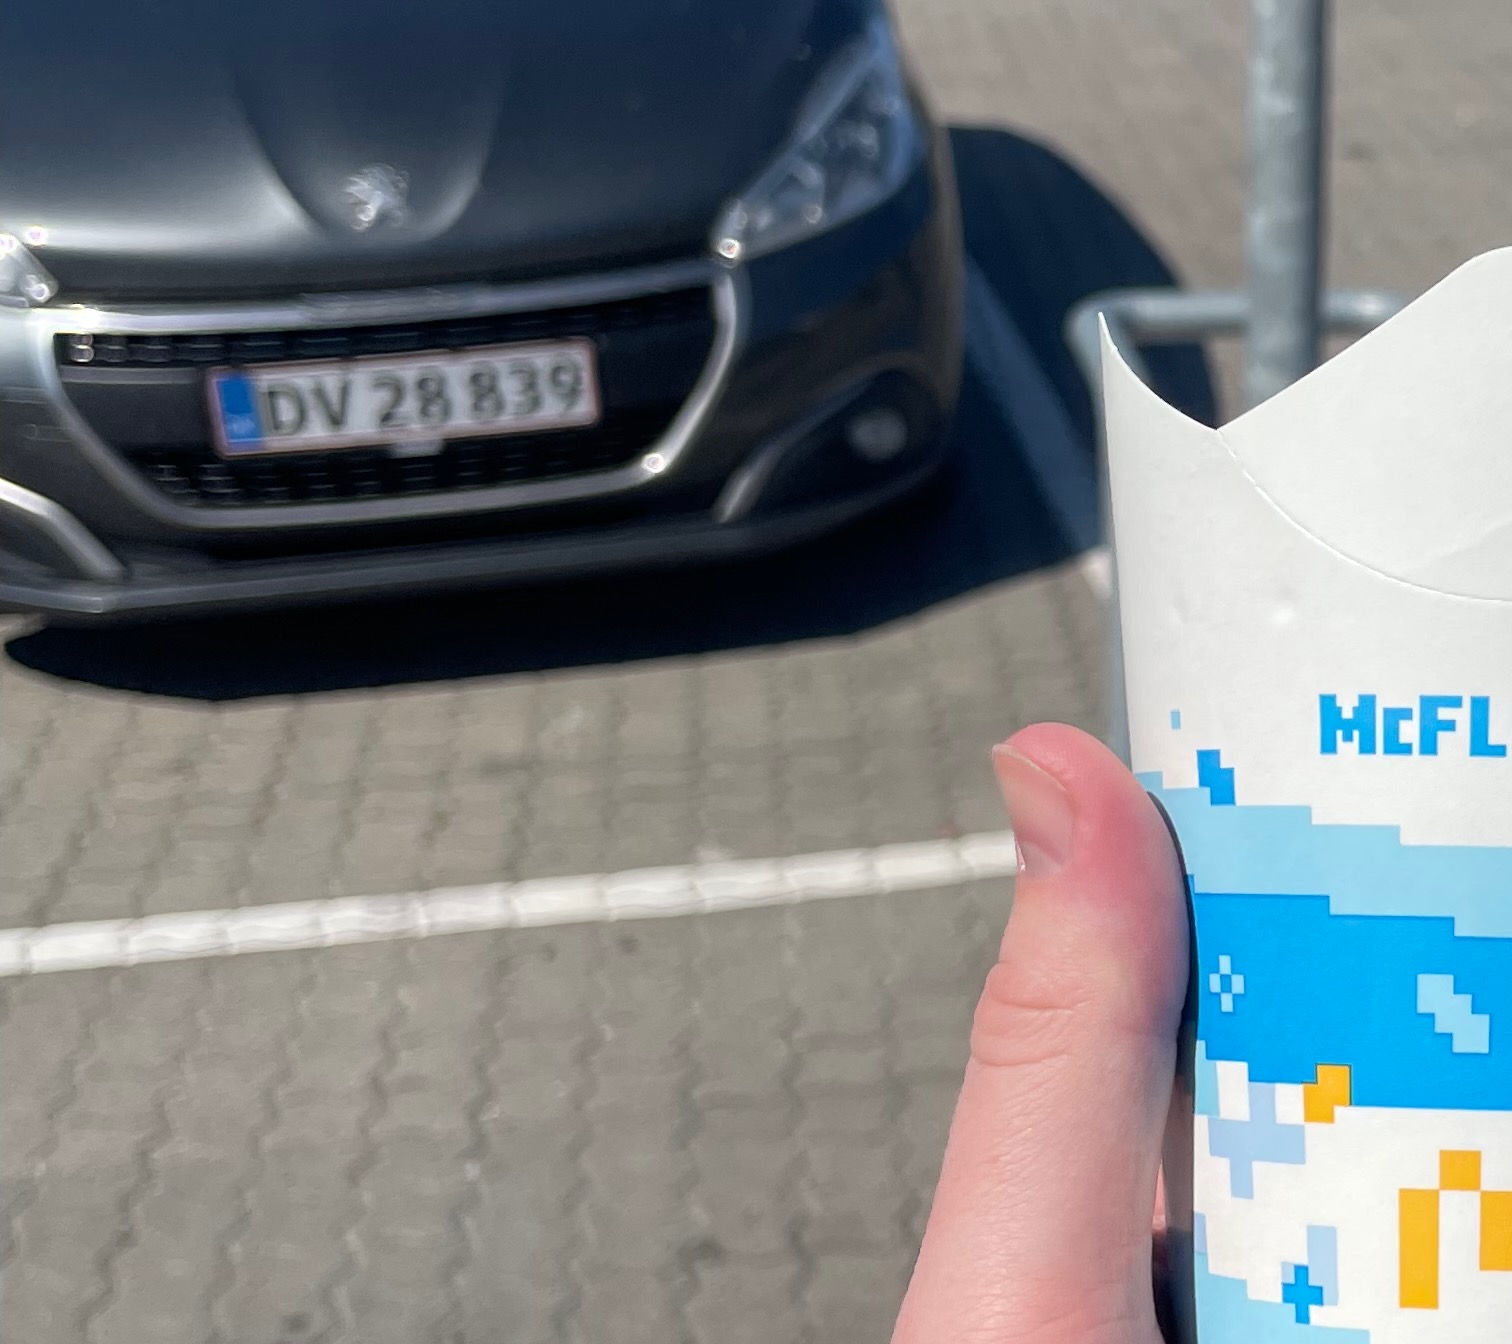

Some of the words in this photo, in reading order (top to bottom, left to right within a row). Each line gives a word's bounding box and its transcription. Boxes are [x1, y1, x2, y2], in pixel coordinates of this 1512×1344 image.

[264, 377, 351, 435] DV
[370, 367, 451, 428] 28
[468, 353, 584, 418] 839
